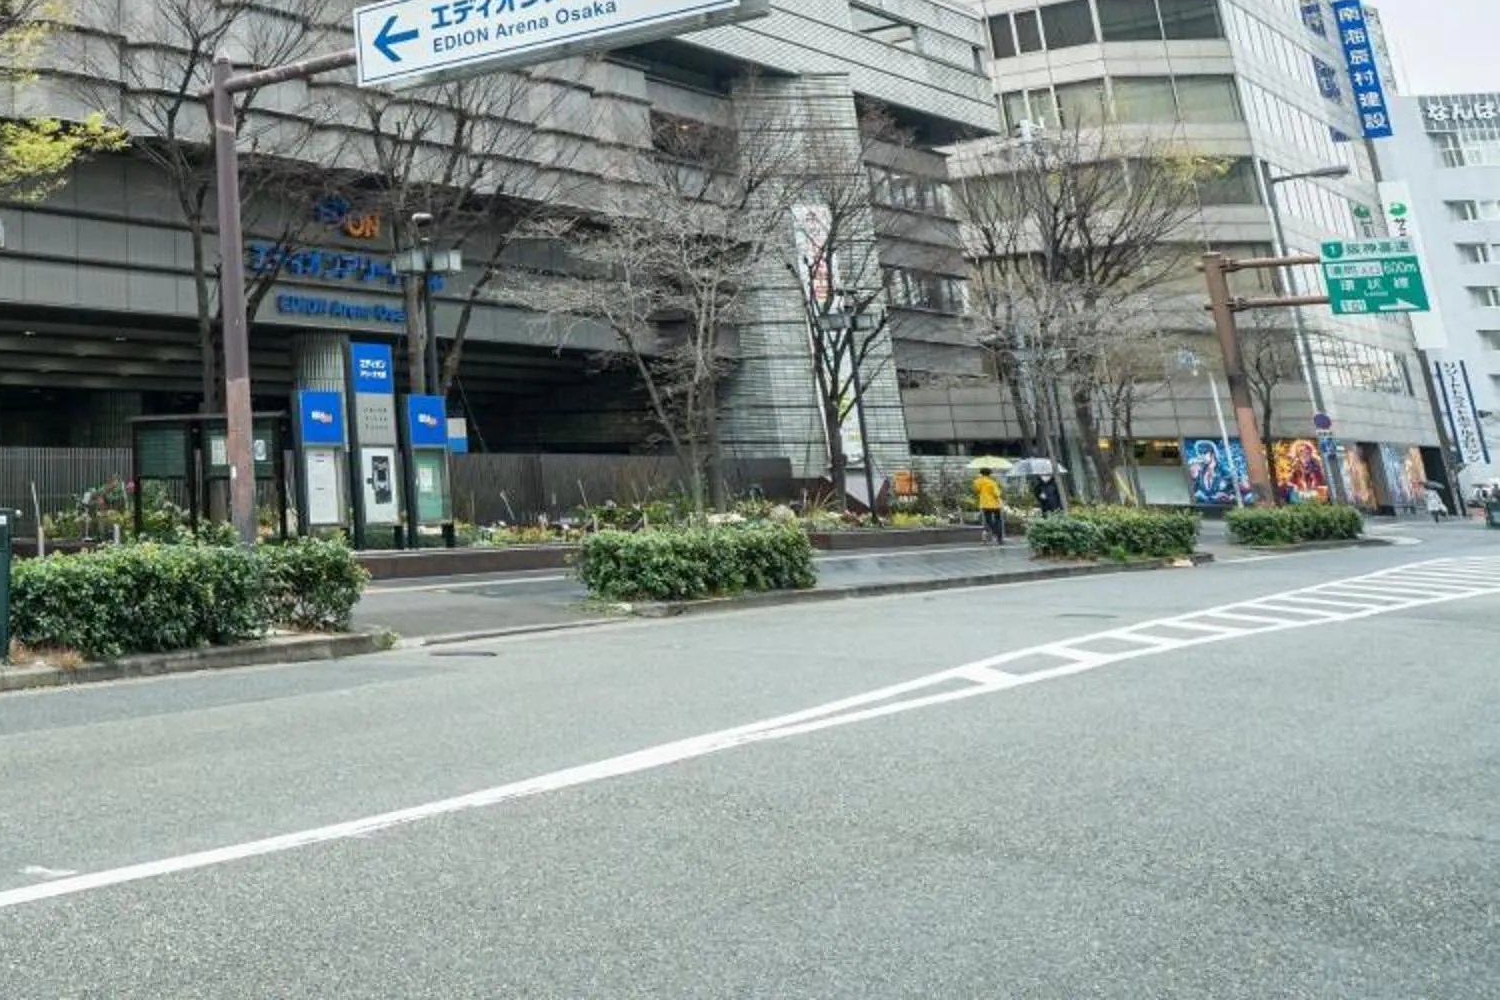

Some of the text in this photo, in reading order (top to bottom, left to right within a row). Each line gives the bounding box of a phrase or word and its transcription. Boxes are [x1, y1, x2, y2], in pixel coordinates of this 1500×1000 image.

[433, 0, 617, 53] EDION Arena Osaka
